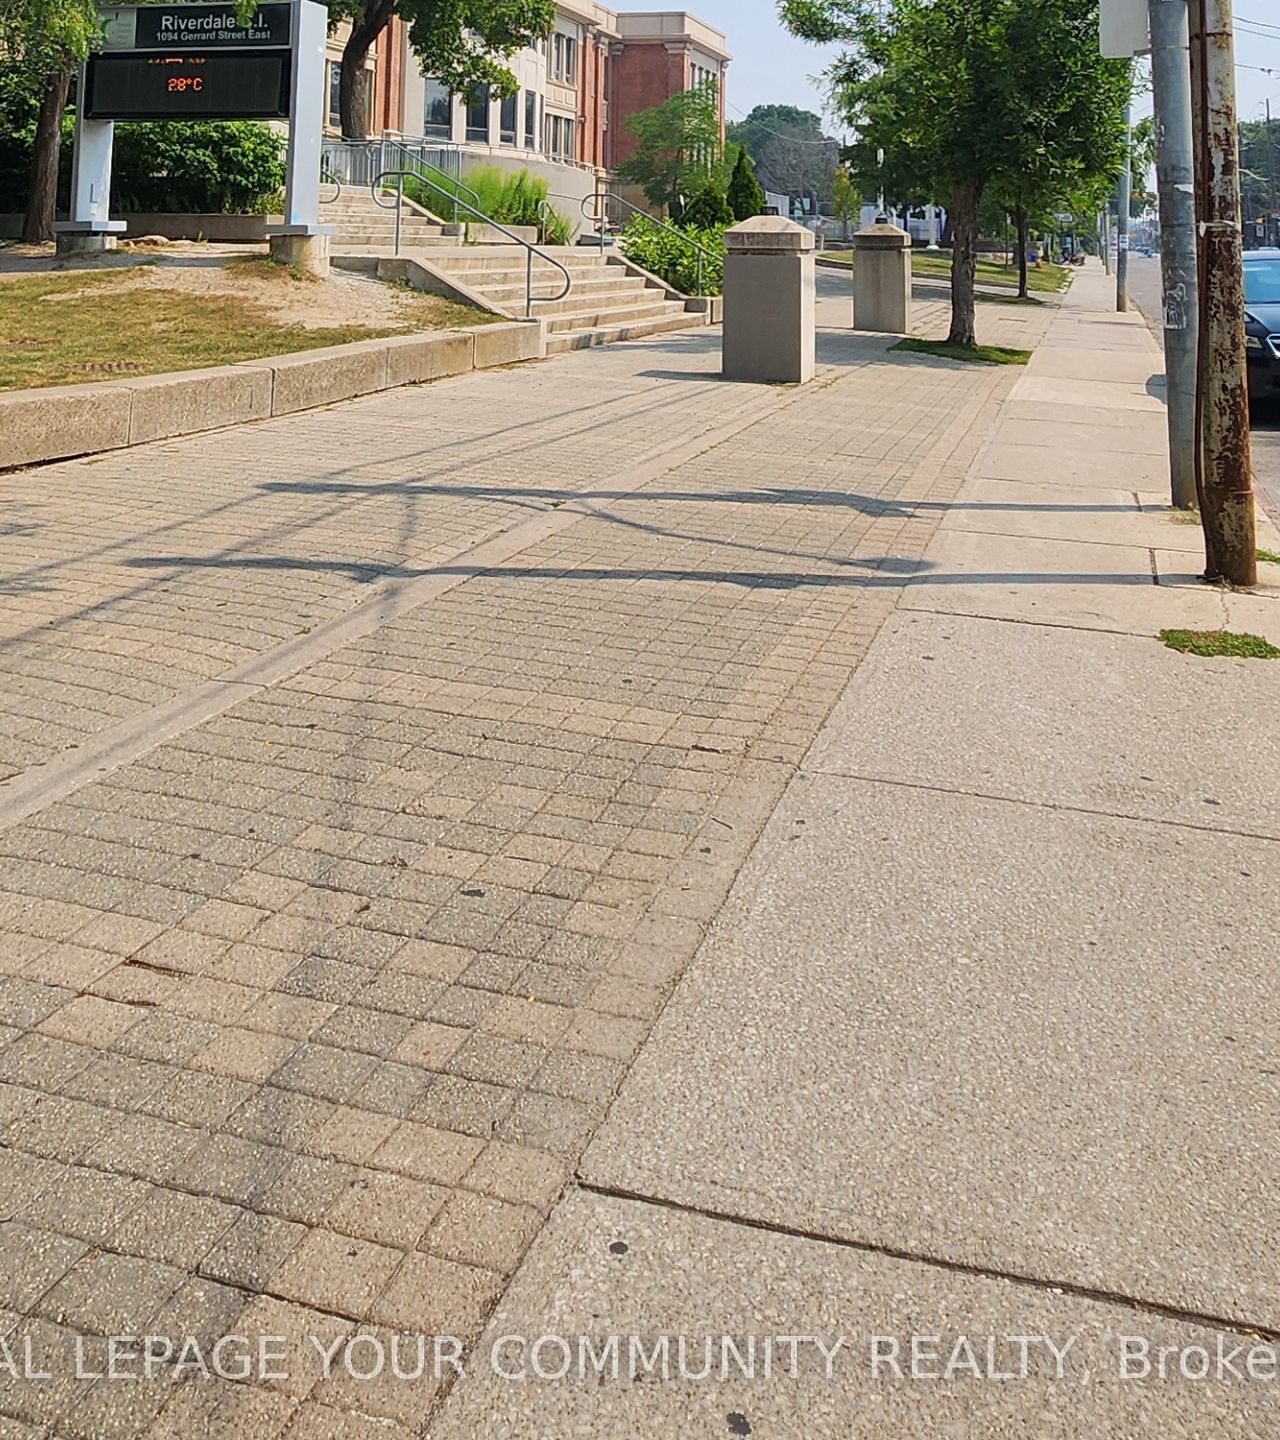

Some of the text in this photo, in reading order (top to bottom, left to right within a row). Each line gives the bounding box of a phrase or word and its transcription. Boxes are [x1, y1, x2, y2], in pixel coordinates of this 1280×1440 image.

[161, 13, 236, 30] Riverdale
[156, 29, 271, 41] 1094 Gerrard Street East
[168, 77, 204, 92] 28°C
